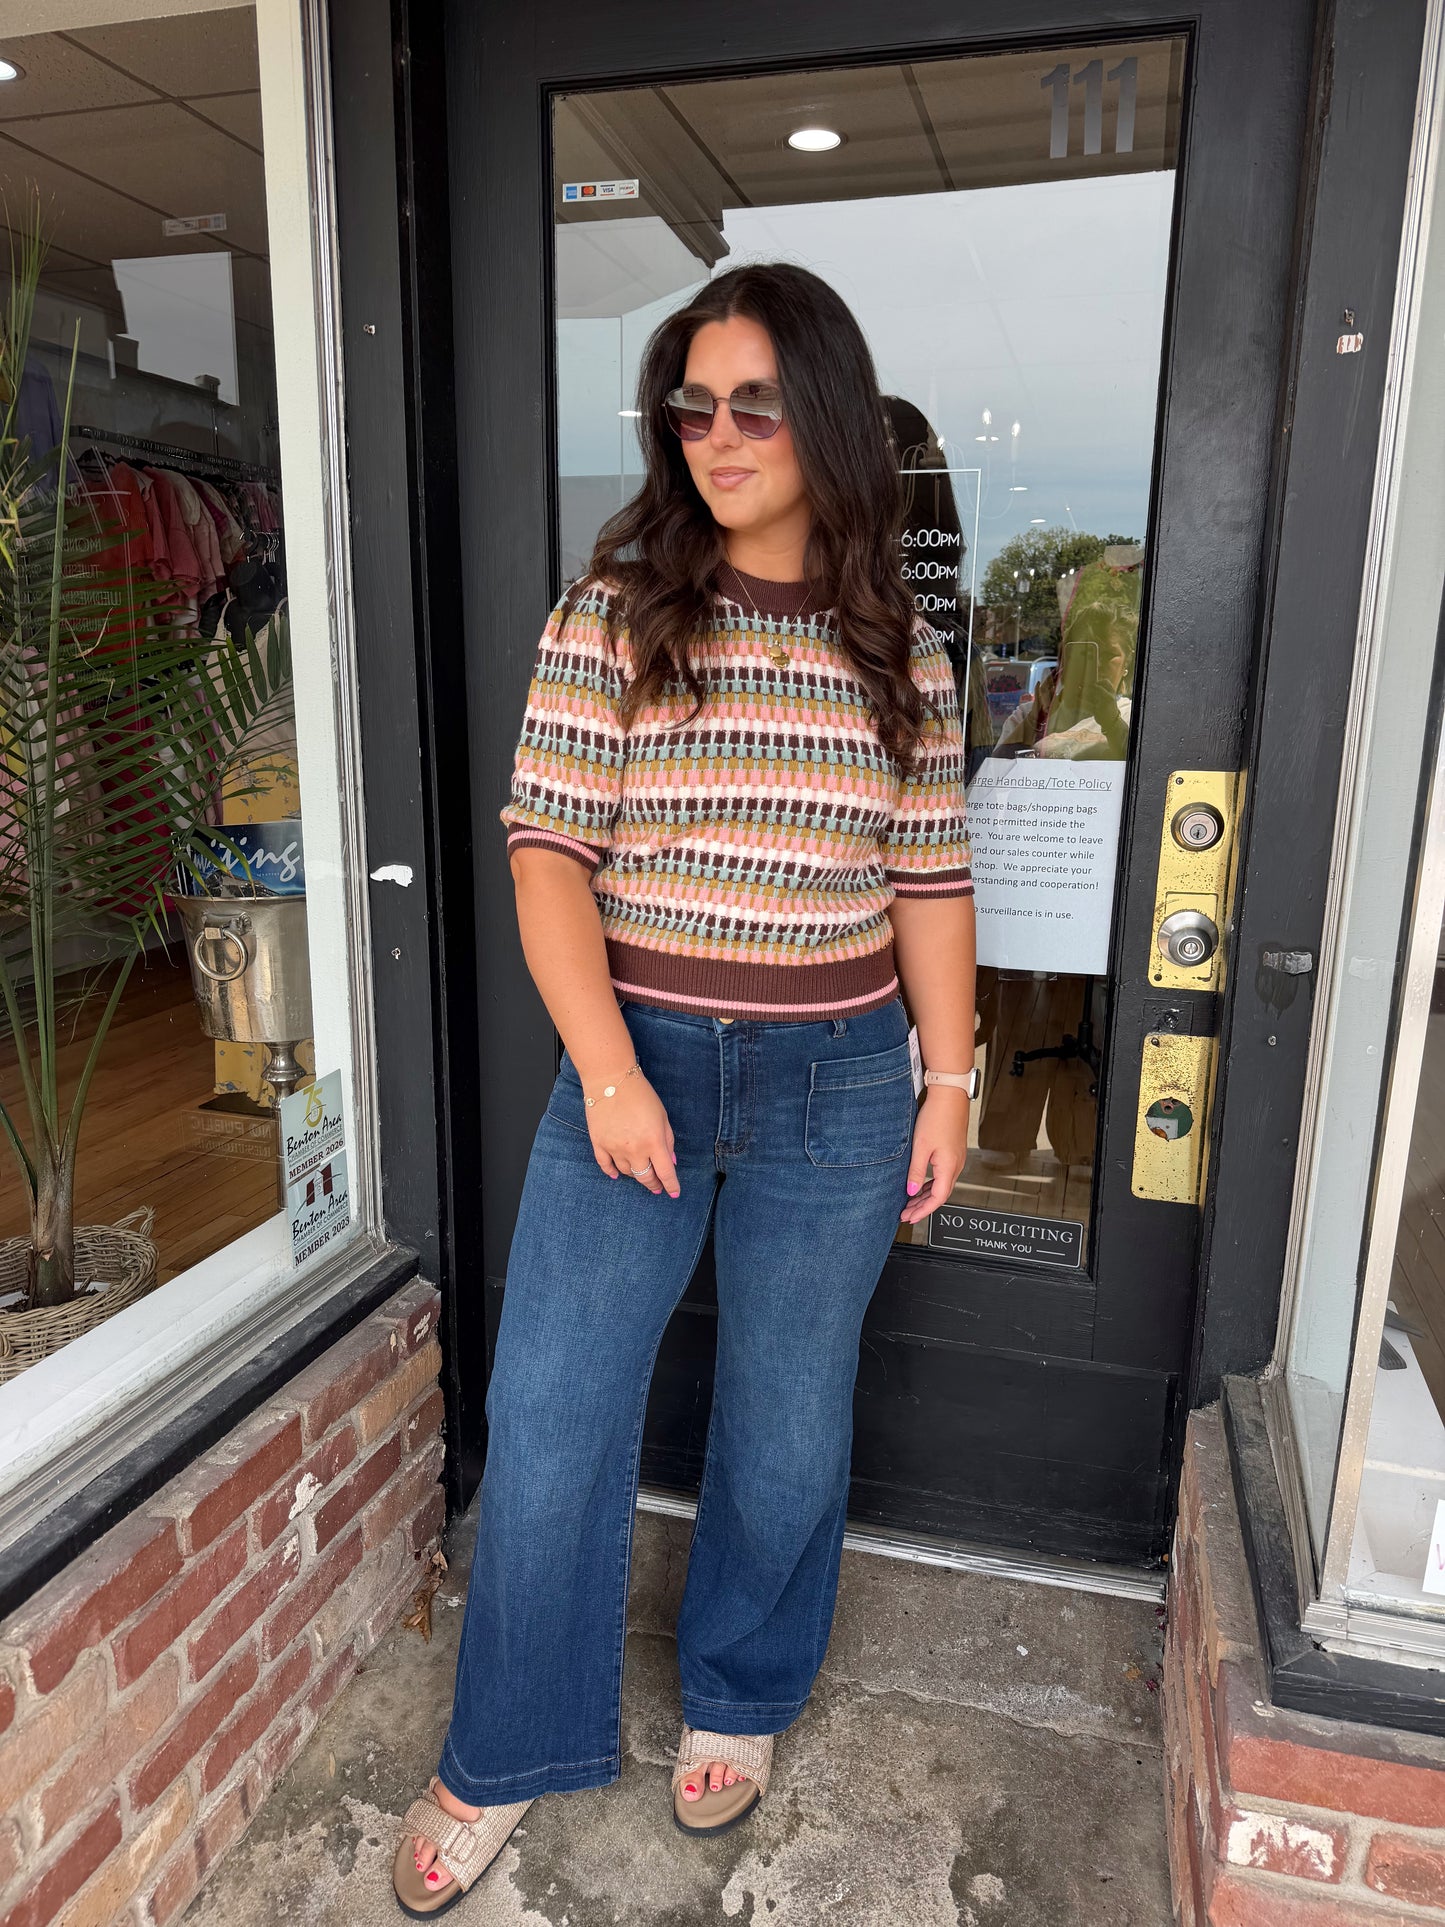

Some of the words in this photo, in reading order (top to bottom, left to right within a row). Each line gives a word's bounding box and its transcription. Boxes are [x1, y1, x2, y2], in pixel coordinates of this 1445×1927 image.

[1041, 56, 1138, 159] 111
[901, 529, 960, 547] 6:00PM
[901, 561, 958, 580] 6:00PM
[914, 593, 957, 612] 00PM
[996, 777, 1076, 789] Handbag/Tote
[1079, 778, 1112, 791] Policy
[966, 802, 984, 810] arge
[986, 802, 1004, 810] tote
[1007, 802, 1074, 814] bags/shopping
[1076, 804, 1098, 814] bags
[976, 817, 990, 825] not
[993, 817, 1038, 828] permitted
[1040, 820, 1067, 828] inside
[1070, 820, 1085, 829] the
[988, 832, 1004, 841] You
[1023, 834, 1064, 844] welcome
[1067, 836, 1077, 844] to
[1079, 836, 1103, 845] leave
[1007, 848, 1029, 857] sales
[1031, 850, 1066, 859] counter
[1069, 850, 1094, 860] while
[974, 861, 998, 871] shop.
[1003, 863, 1018, 871] We
[1020, 864, 1068, 875] appreciate
[1071, 867, 1092, 876] your
[973, 876, 1018, 888] erstanding
[1020, 879, 1037, 888] and
[1040, 881, 1099, 892] cooperation!
[980, 907, 1033, 917] surveillance
[1035, 909, 1043, 917] is
[1045, 910, 1053, 918] in
[1055, 912, 1074, 920] use.
[303, 1085, 323, 1127] 75
[287, 1130, 320, 1156] Benton
[322, 1113, 342, 1134] Area
[289, 1151, 324, 1180] MEMBER
[326, 1138, 344, 1156] 2026
[292, 1209, 326, 1240] Benton
[328, 1190, 348, 1213] Area
[939, 1213, 964, 1228] NO
[969, 1217, 1074, 1244] SOLICITING
[294, 1231, 330, 1267] MEMBER
[975, 1237, 1008, 1251] THANK
[1010, 1243, 1033, 1254] YOU
